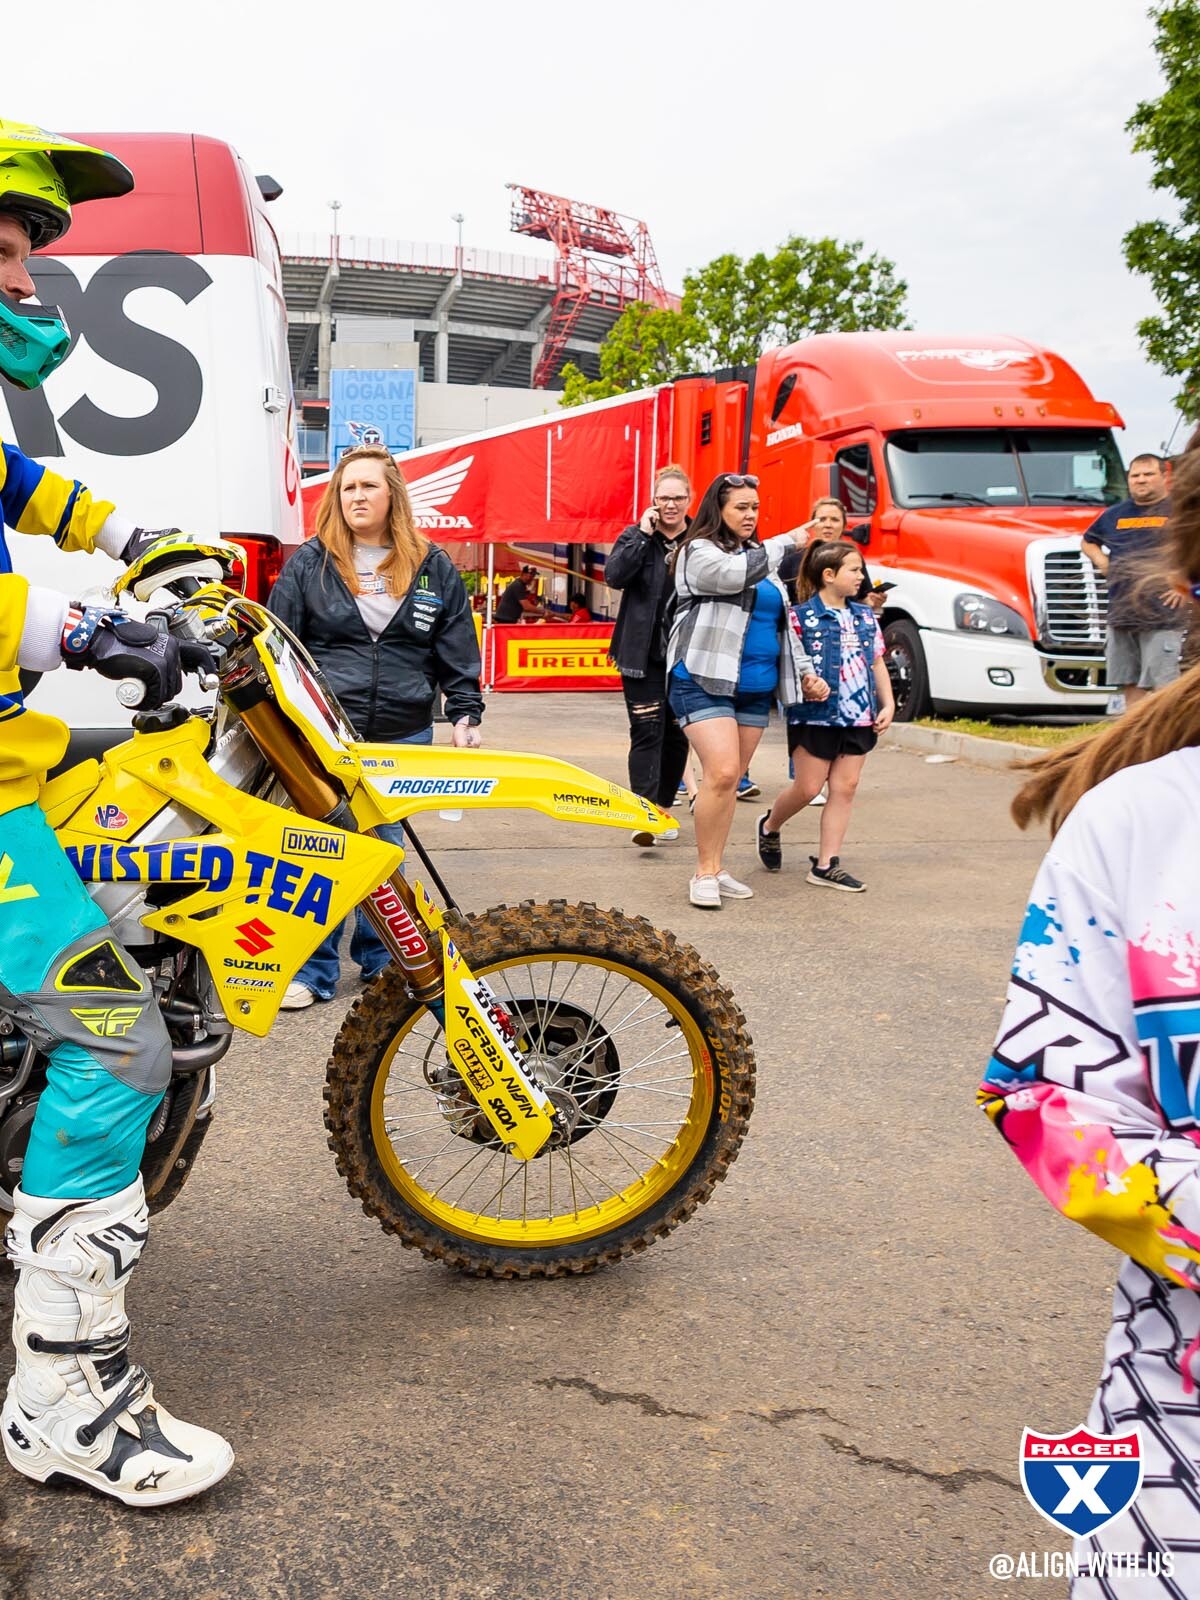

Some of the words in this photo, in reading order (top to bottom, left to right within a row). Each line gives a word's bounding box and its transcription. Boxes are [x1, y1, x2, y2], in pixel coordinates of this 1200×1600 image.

[361, 759, 394, 768] WD-40
[388, 779, 495, 796] PROGRESSIVE
[553, 793, 610, 808] MAYHEM
[97, 804, 119, 828] VP
[287, 831, 341, 854] DIXXON
[245, 850, 334, 926] TEA
[223, 958, 281, 972] SUZUKI
[226, 976, 275, 988] ECSTAR
[454, 1038, 494, 1090] GALFER
[501, 1077, 538, 1120] NISSIN
